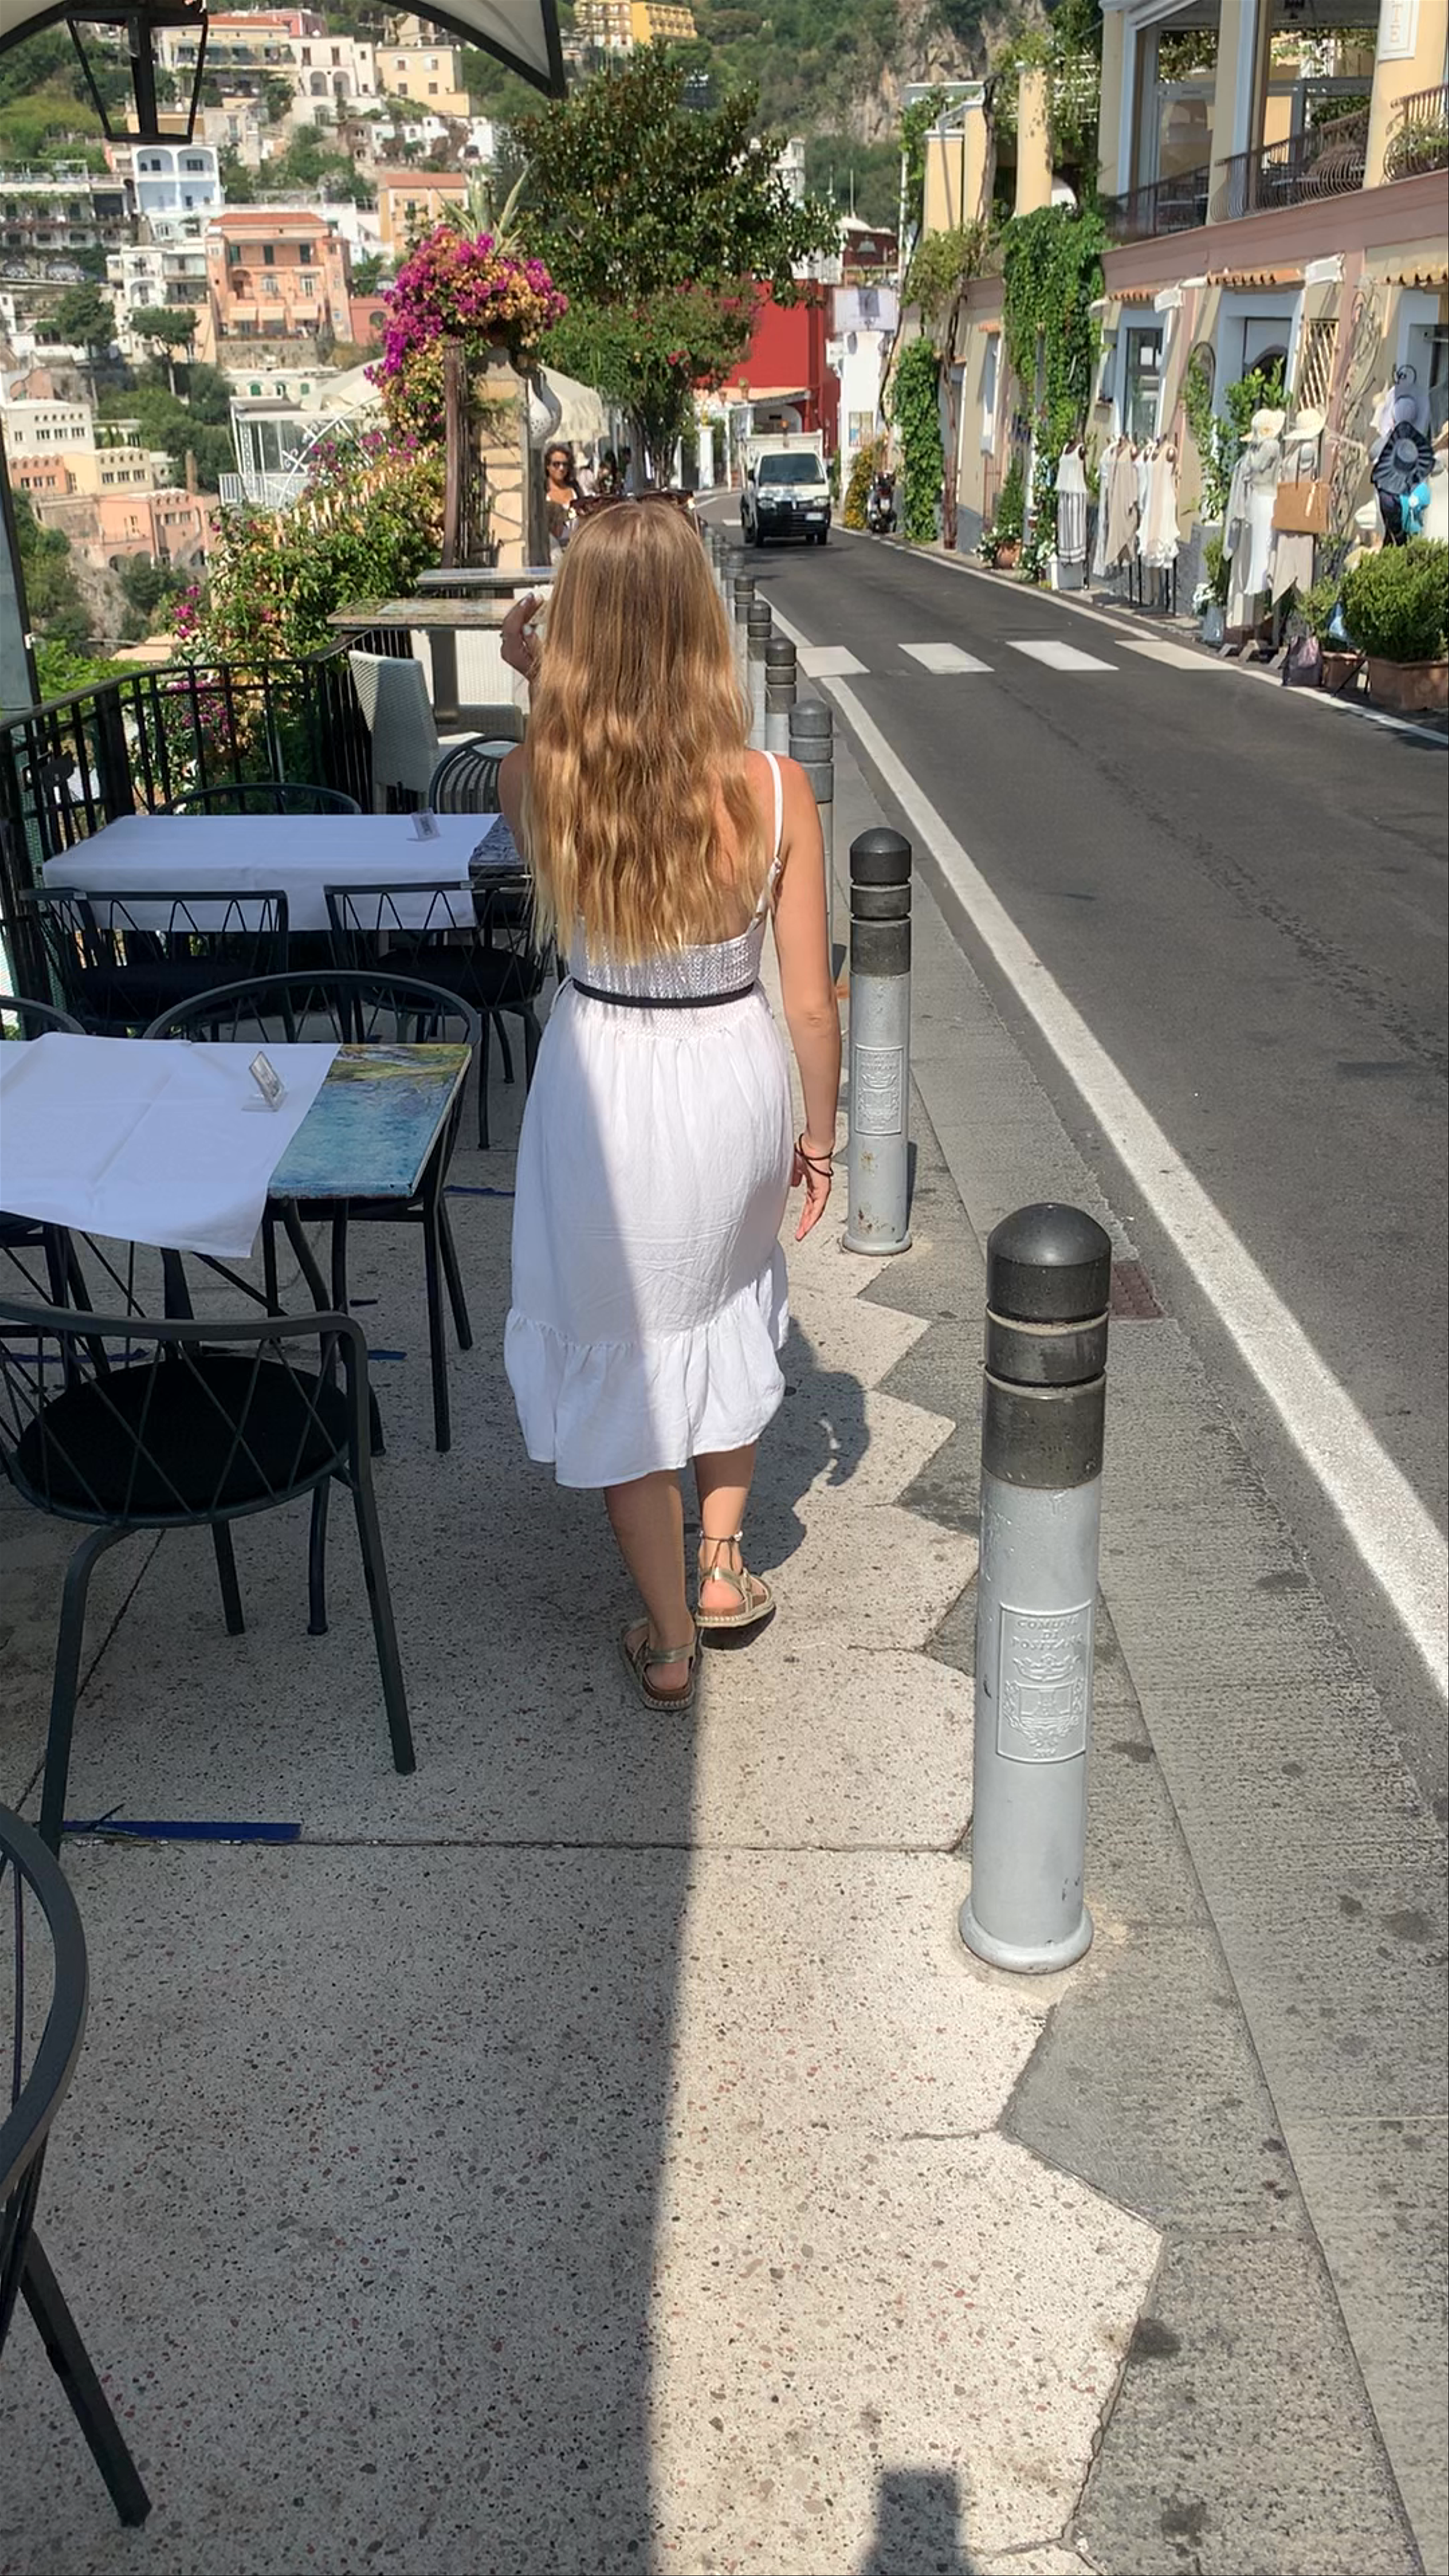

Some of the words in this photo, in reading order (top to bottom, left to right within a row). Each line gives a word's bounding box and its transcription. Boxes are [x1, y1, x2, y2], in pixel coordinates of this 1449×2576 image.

[1017, 1616, 1079, 1630] COMUNE
[1011, 1632, 1084, 1651] POSITANO
[1043, 1630, 1058, 1640] DI
